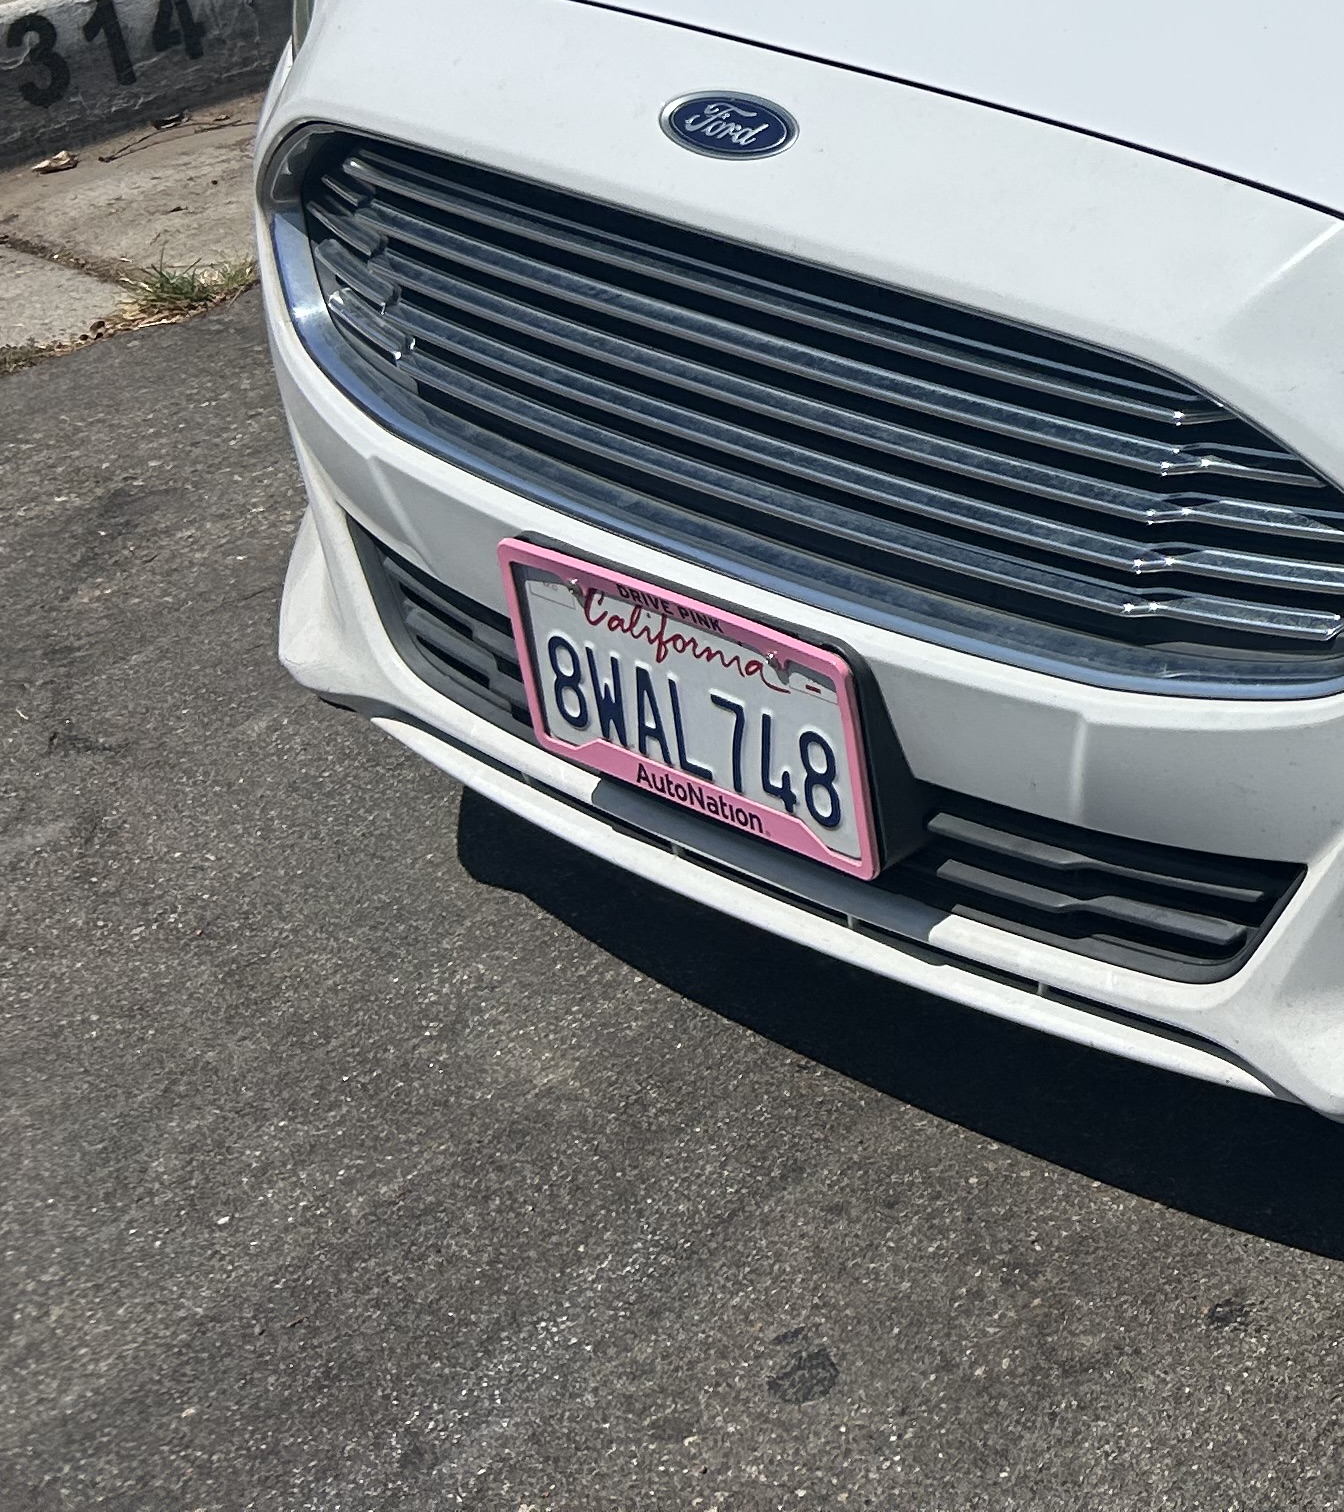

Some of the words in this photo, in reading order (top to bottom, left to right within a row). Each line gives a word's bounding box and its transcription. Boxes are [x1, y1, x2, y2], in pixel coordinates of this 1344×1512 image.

[685, 102, 769, 146] Ford
[583, 587, 791, 694] California
[616, 584, 674, 615] DRIVE
[677, 606, 724, 634] PINK
[548, 635, 841, 829] 8WAL748
[635, 762, 764, 834] AutoNation
